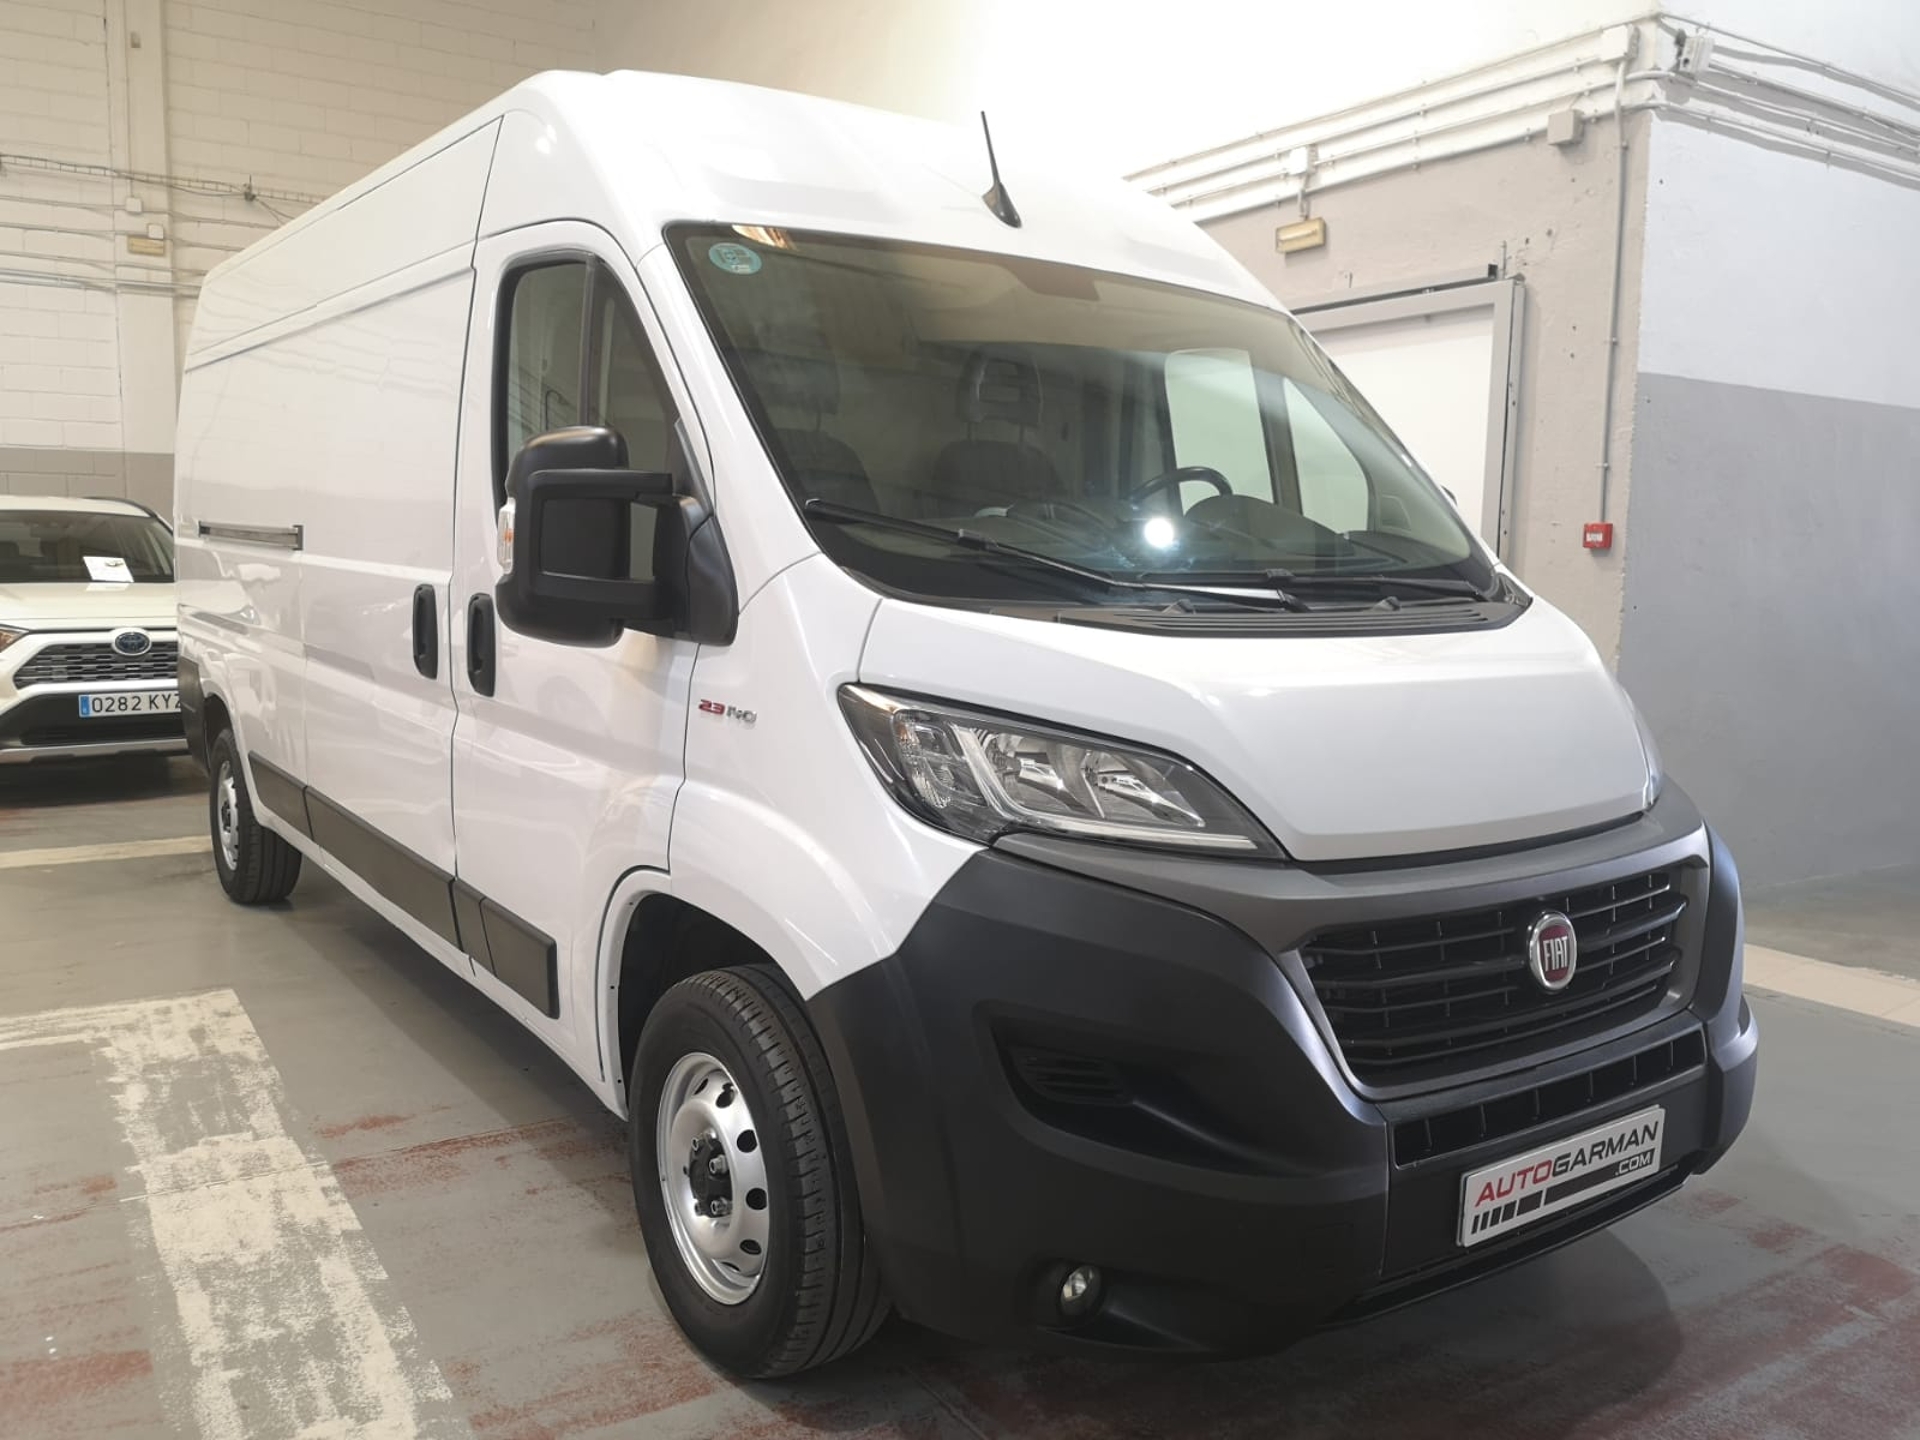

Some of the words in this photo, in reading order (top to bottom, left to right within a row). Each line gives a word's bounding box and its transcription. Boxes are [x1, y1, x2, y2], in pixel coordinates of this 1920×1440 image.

[92, 695, 142, 713] 0282
[1543, 935, 1568, 972] FIAT
[1475, 1121, 1659, 1208] AUTOGARMAN
